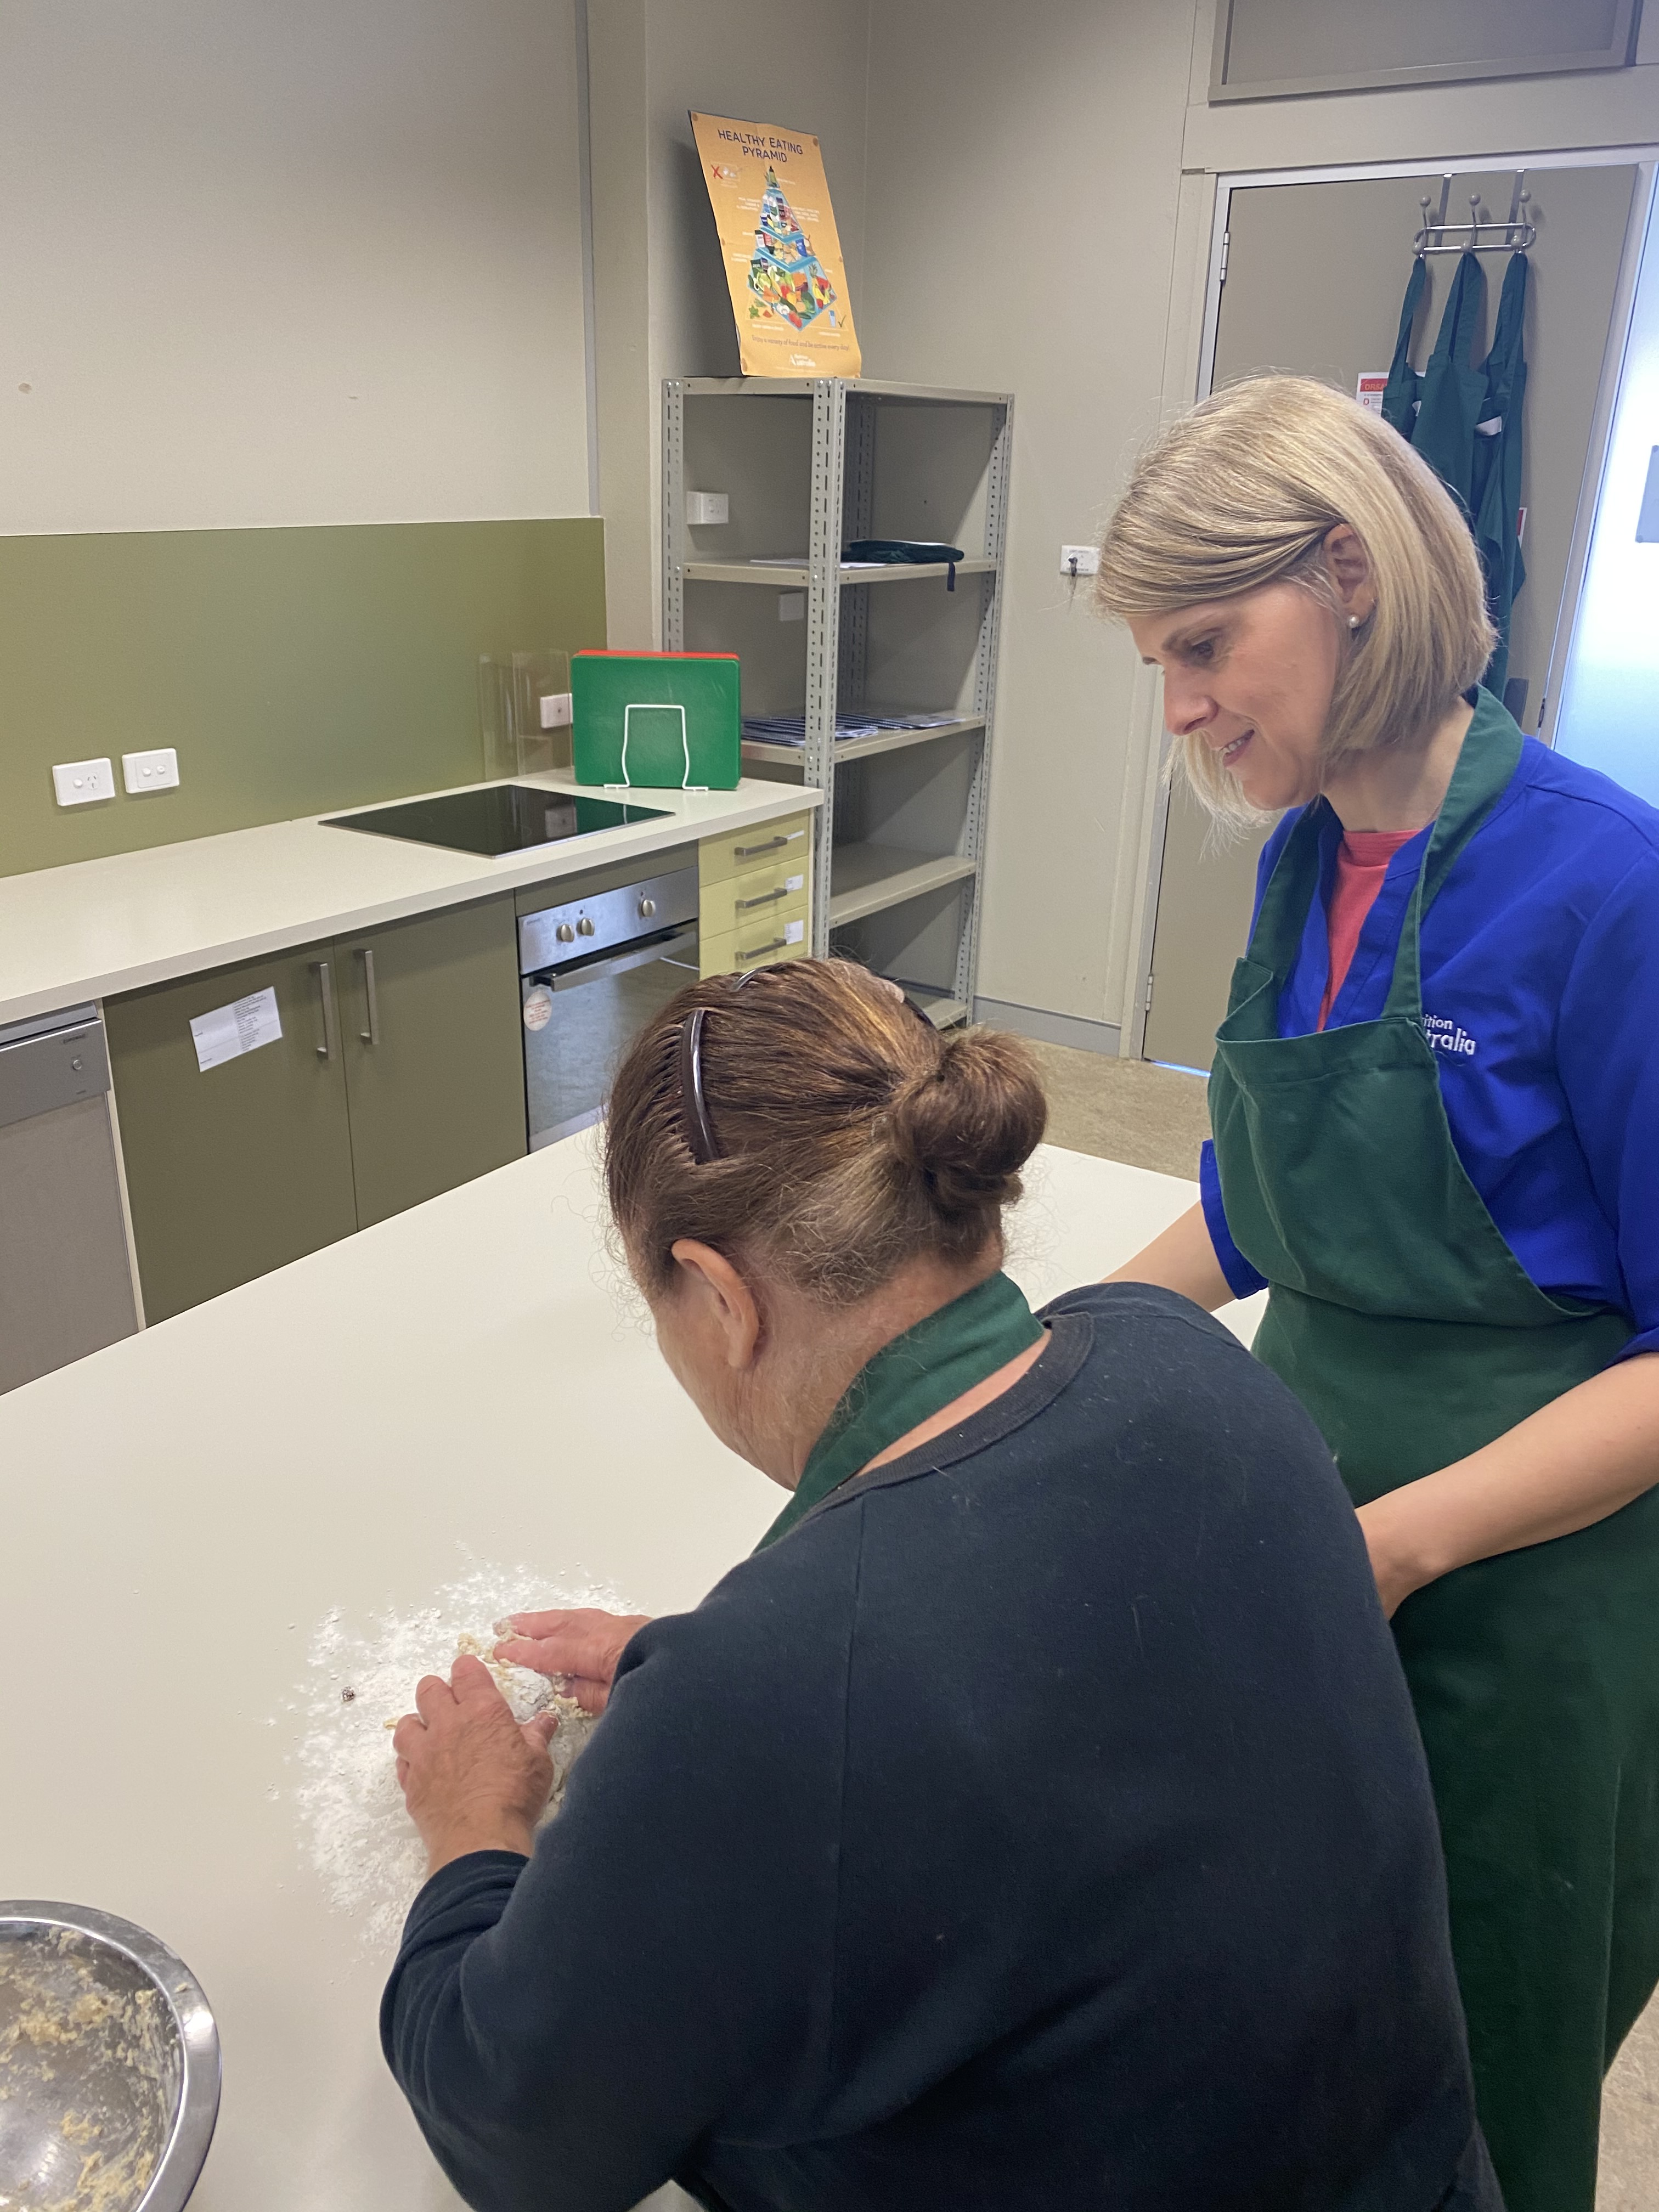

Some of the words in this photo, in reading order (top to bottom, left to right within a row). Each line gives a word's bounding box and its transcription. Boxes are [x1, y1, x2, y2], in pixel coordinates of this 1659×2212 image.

[718, 129, 765, 146] HEALTHY
[769, 137, 803, 155] EATING
[742, 145, 787, 162] PYRAMID
